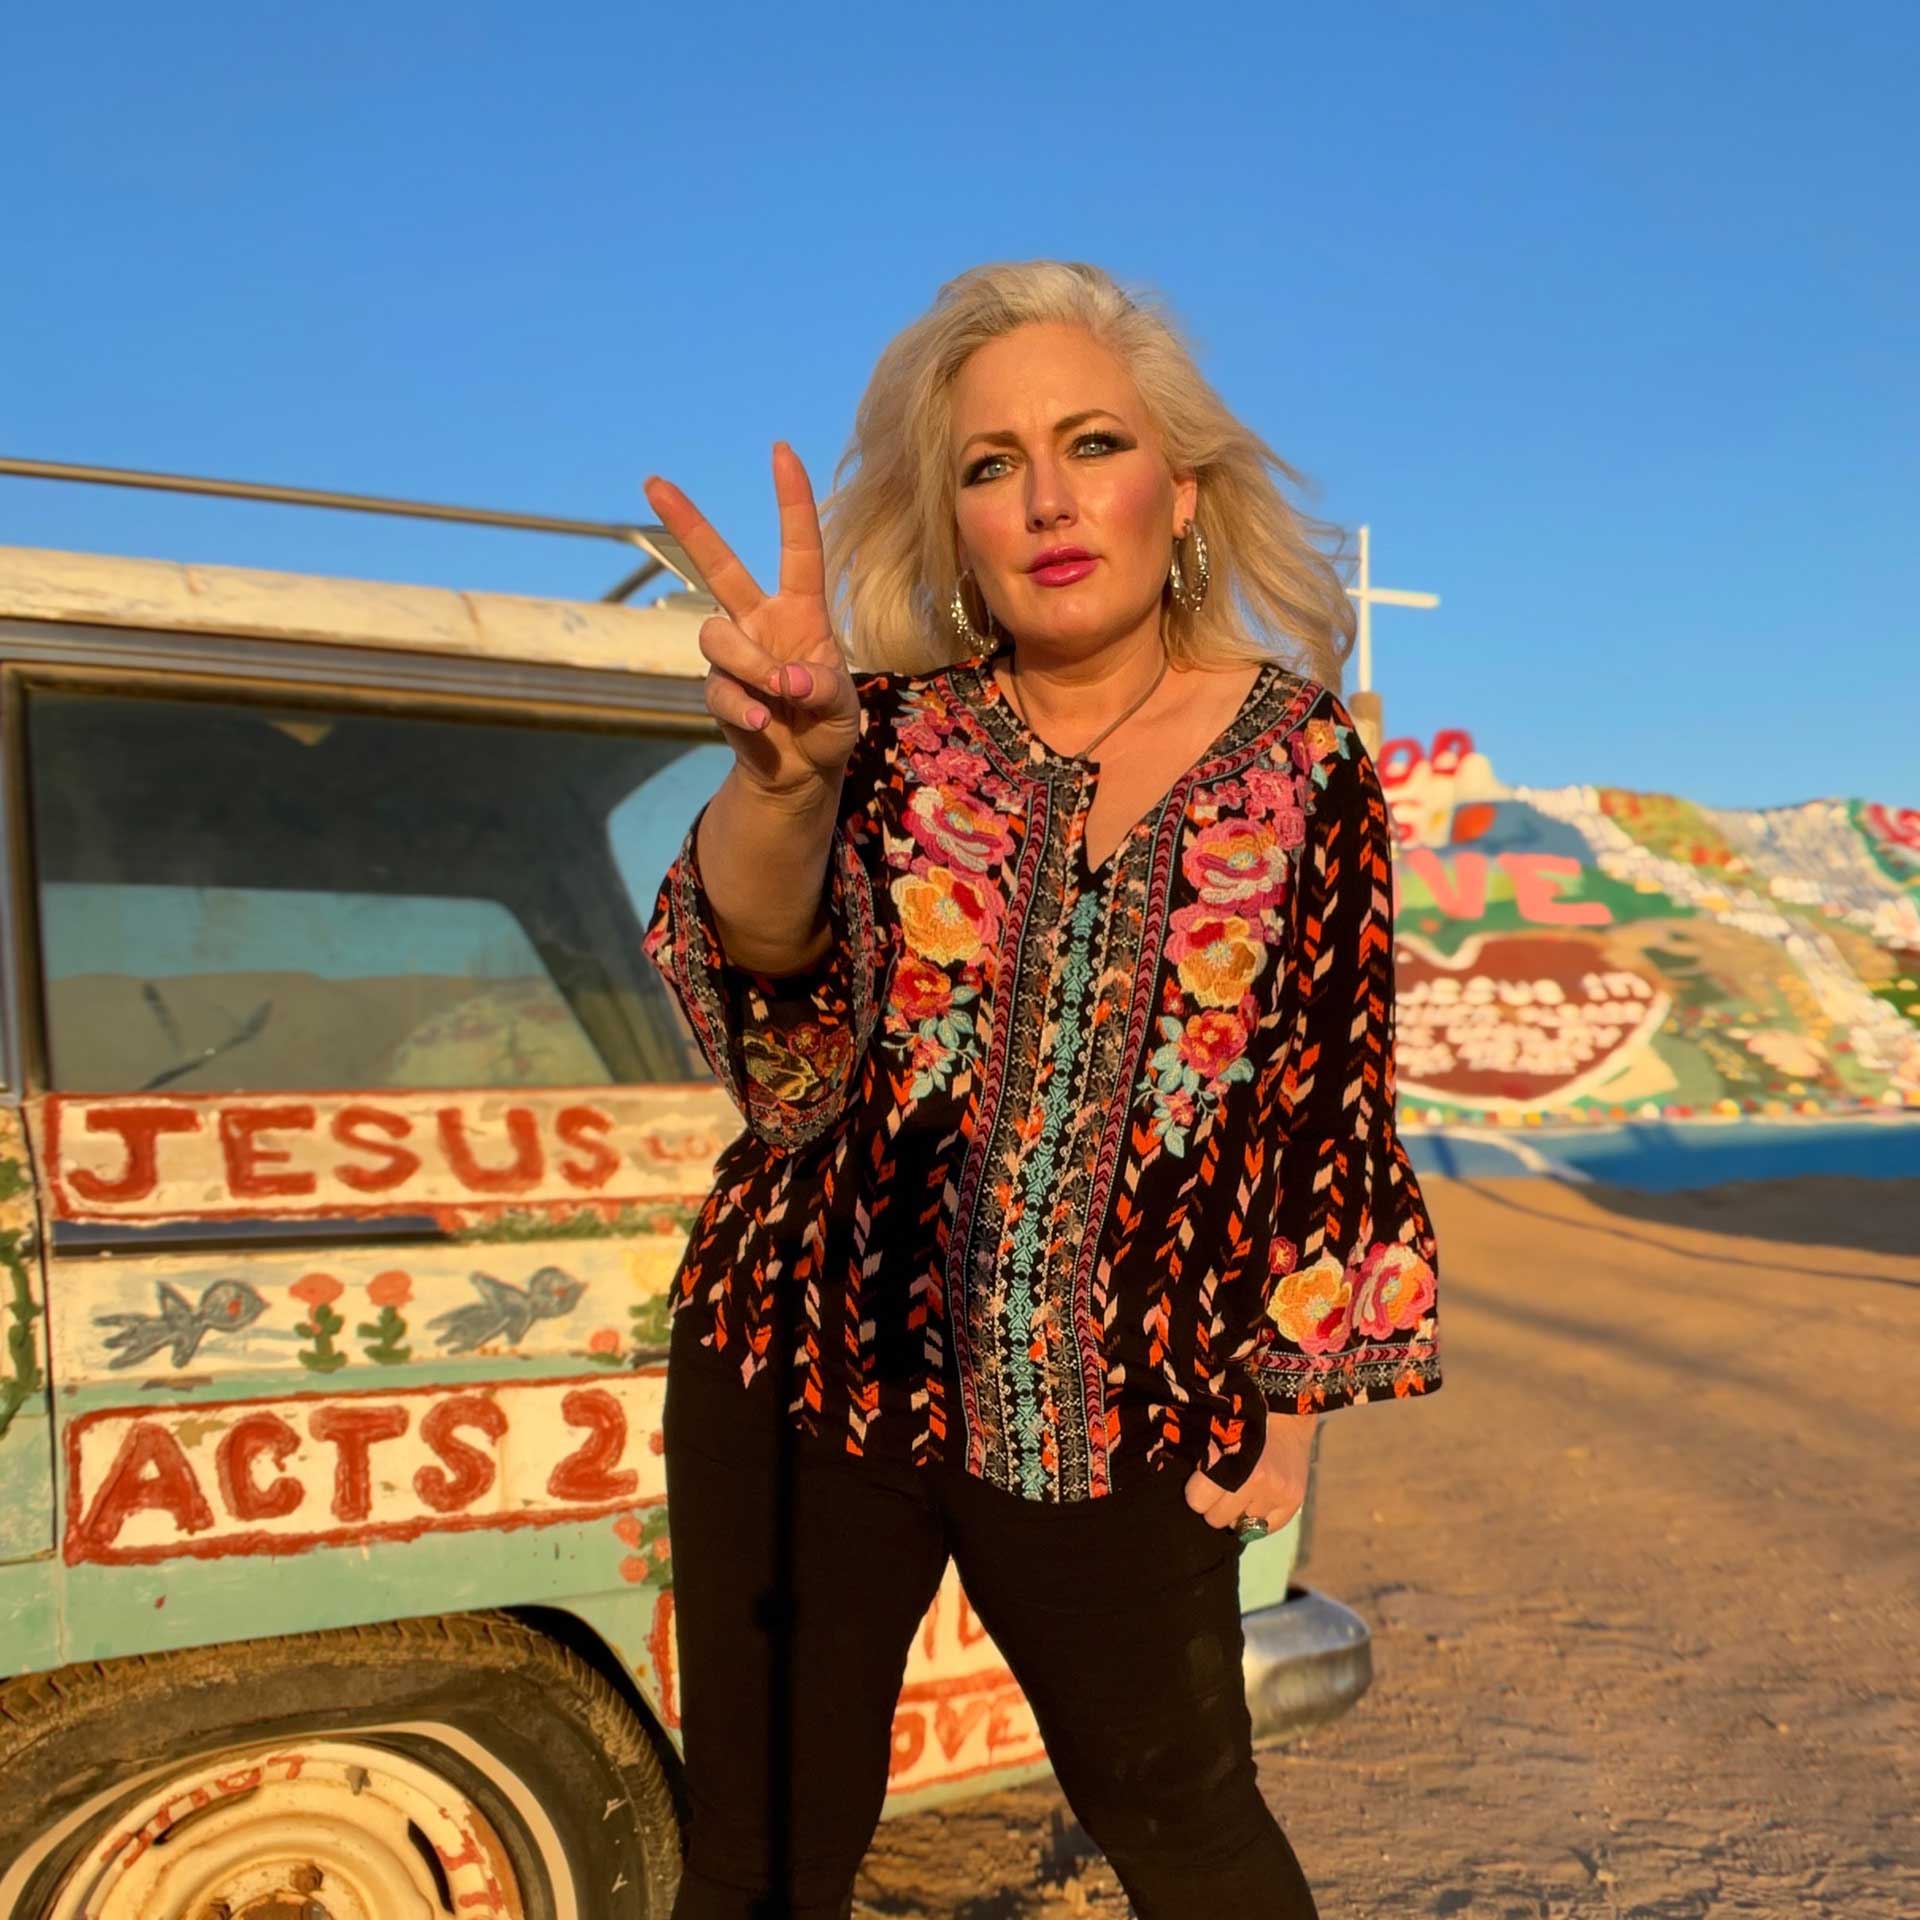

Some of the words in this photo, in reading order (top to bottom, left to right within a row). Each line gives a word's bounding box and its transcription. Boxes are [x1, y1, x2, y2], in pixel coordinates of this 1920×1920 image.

[1377, 729, 1475, 789] OD
[1394, 848, 1613, 926] VE
[67, 1104, 621, 1202] JESUS
[78, 1393, 509, 1544] ACTS
[891, 1689, 1029, 1782] OVE
